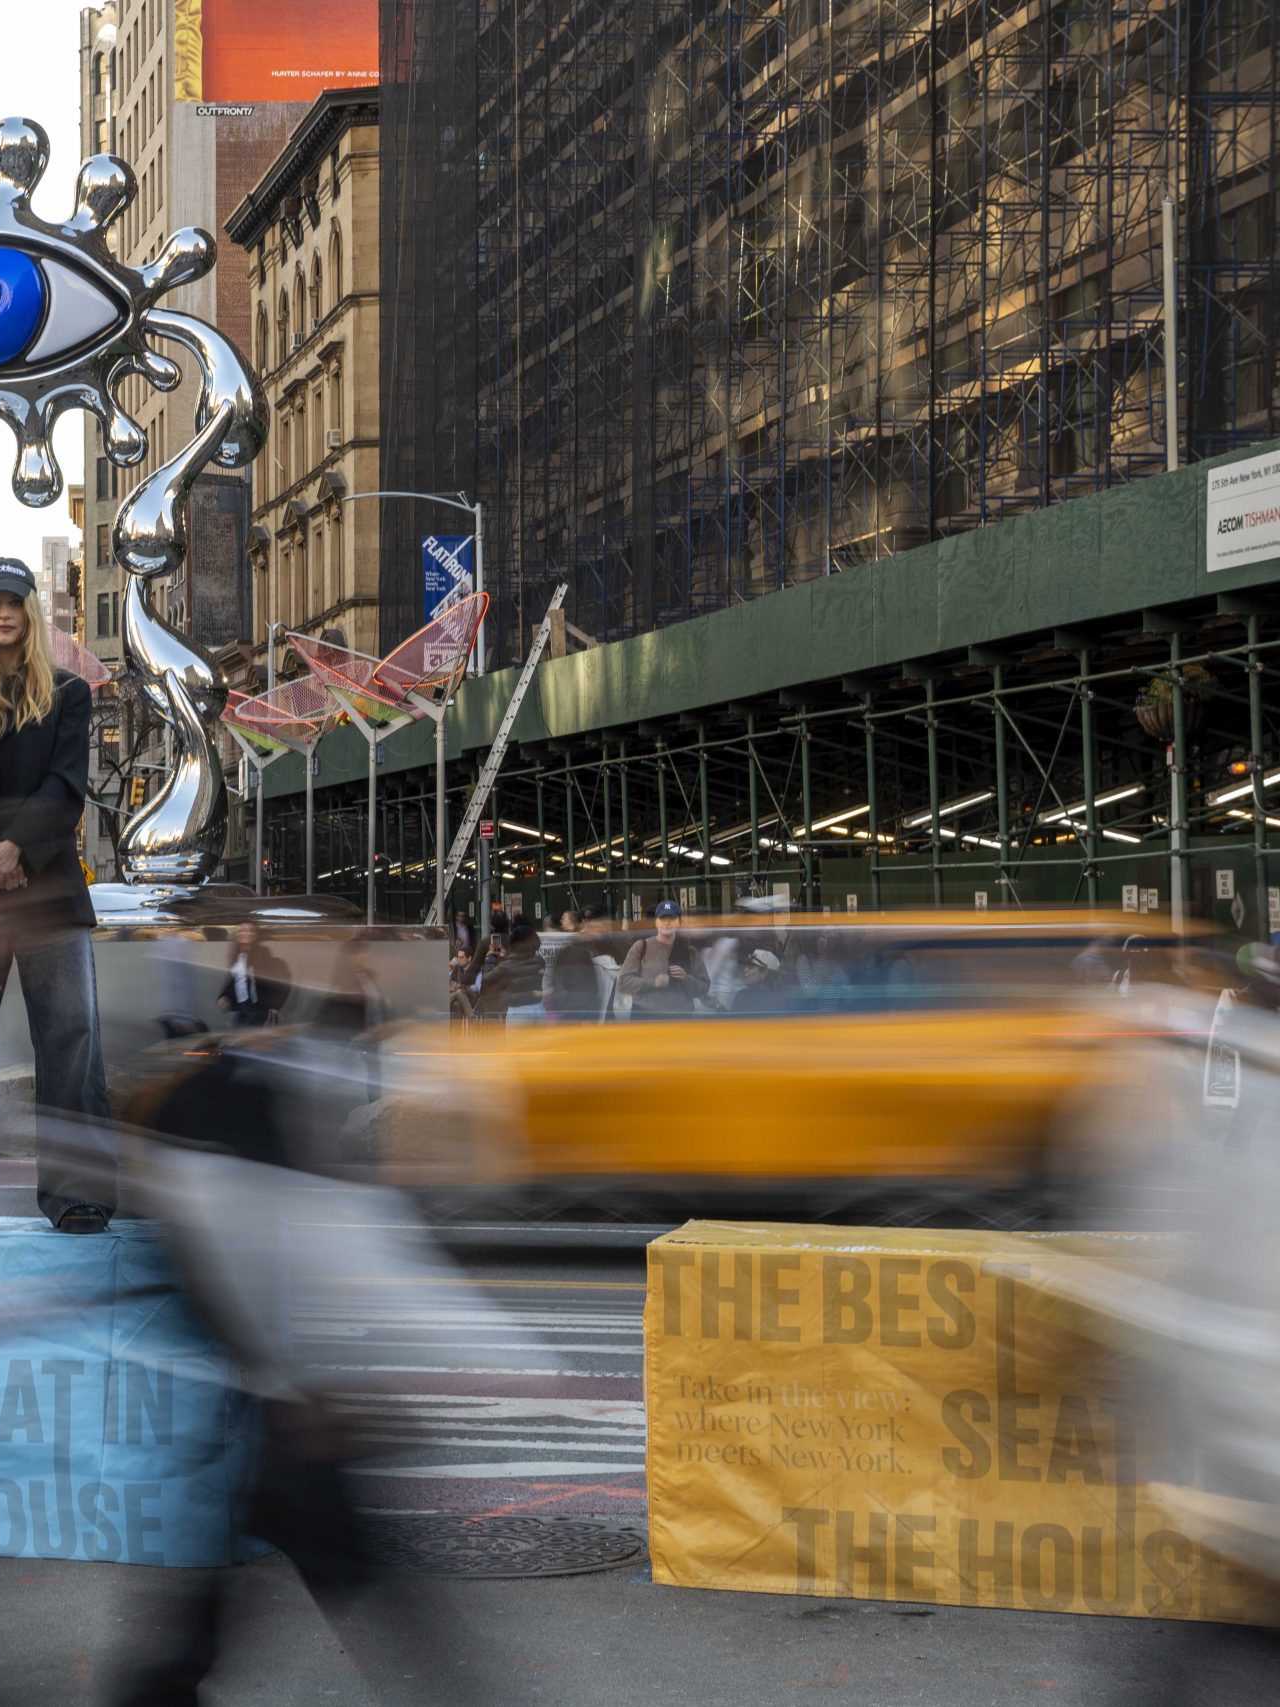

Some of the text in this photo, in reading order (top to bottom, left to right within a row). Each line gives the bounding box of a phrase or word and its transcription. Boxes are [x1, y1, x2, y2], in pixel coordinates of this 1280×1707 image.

[1211, 463, 1280, 491] 175 5th Ave New York, NY 100
[1217, 505, 1280, 535] AECOM TISHMAN
[422, 535, 473, 584] FLATIRON
[649, 1250, 1032, 1393] THE BEST
[103, 1358, 174, 1446] IN
[673, 1373, 912, 1413] Take in the view:
[673, 1404, 907, 1444] where New York
[940, 1387, 1150, 1500] SEAT
[675, 1439, 914, 1476] meets New York.
[781, 1506, 938, 1602] THE
